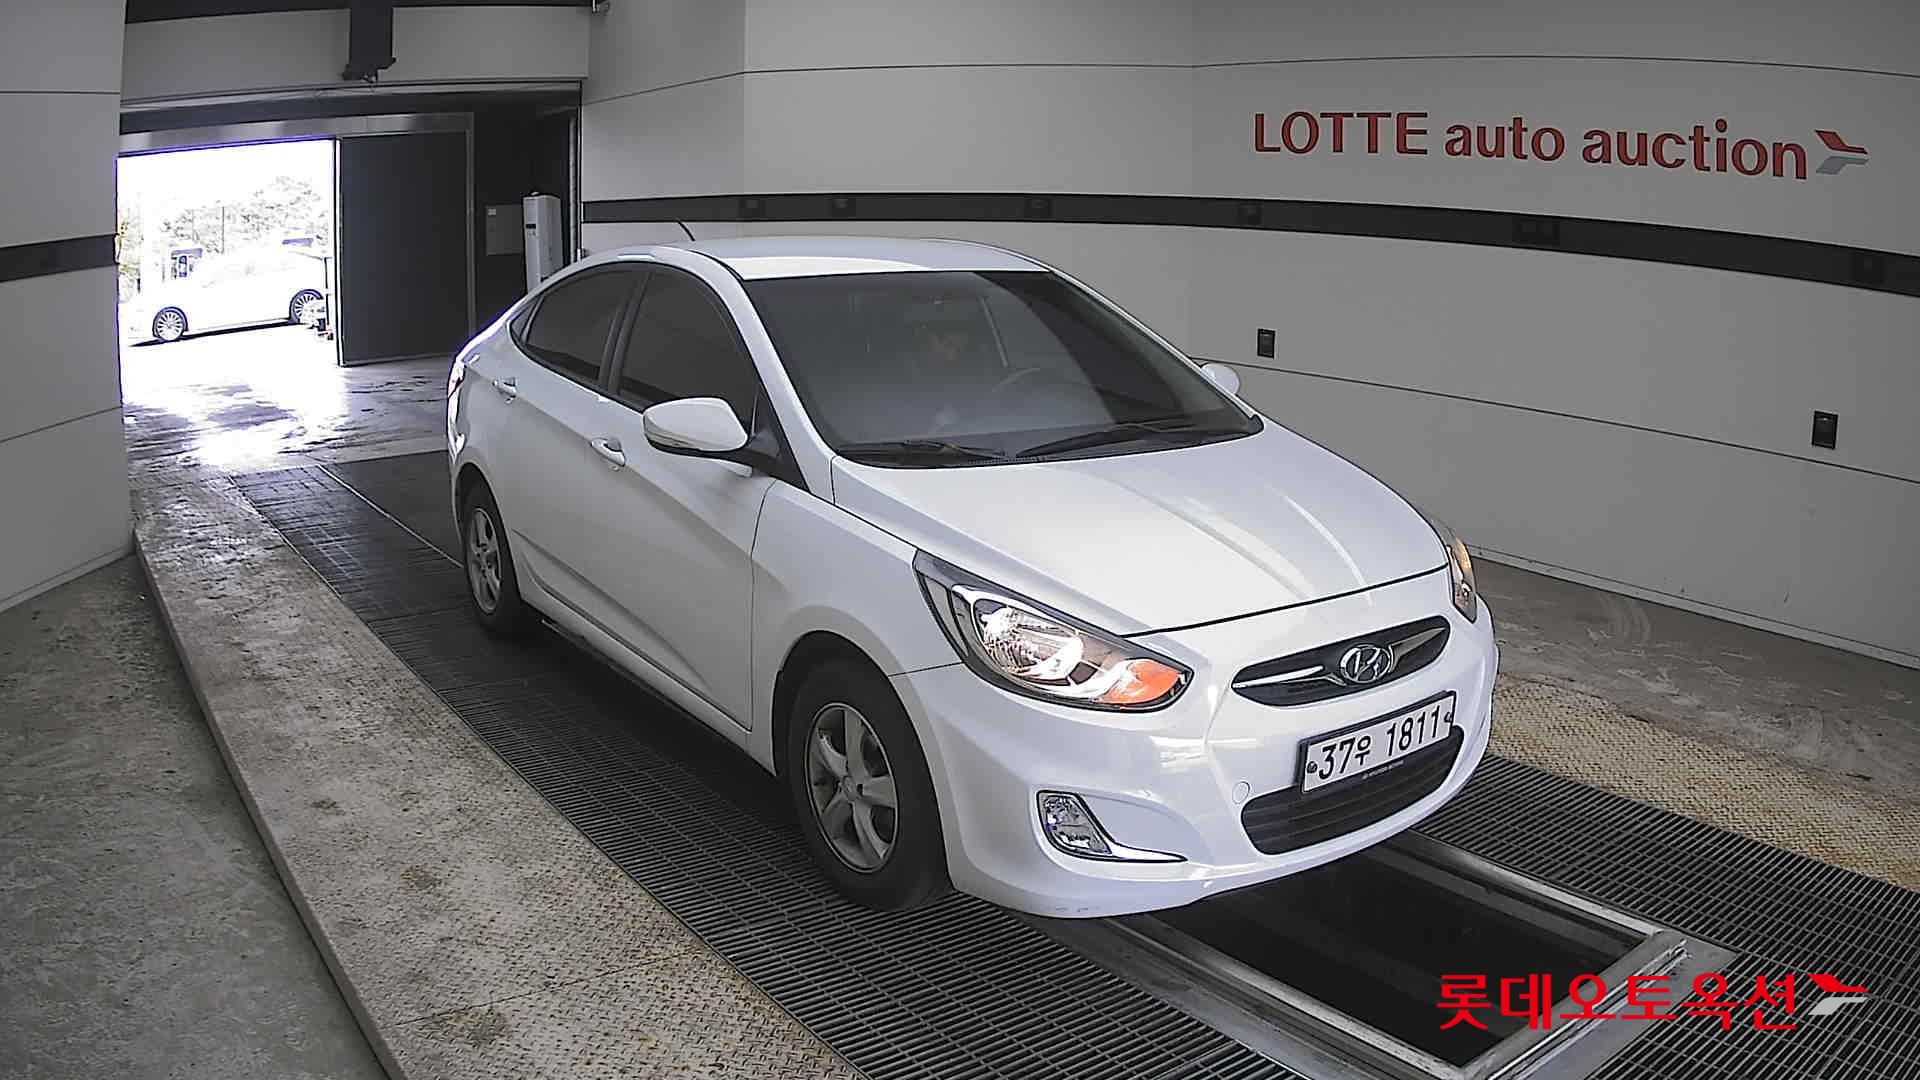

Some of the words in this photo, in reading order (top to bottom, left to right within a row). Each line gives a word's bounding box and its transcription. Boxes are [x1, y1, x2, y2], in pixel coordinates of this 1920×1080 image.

[1254, 111, 1428, 155] LOTTE
[1444, 117, 1566, 162] auto
[1582, 119, 1808, 180] auction
[1318, 735, 1372, 780] 37우
[1386, 705, 1441, 757] 1811
